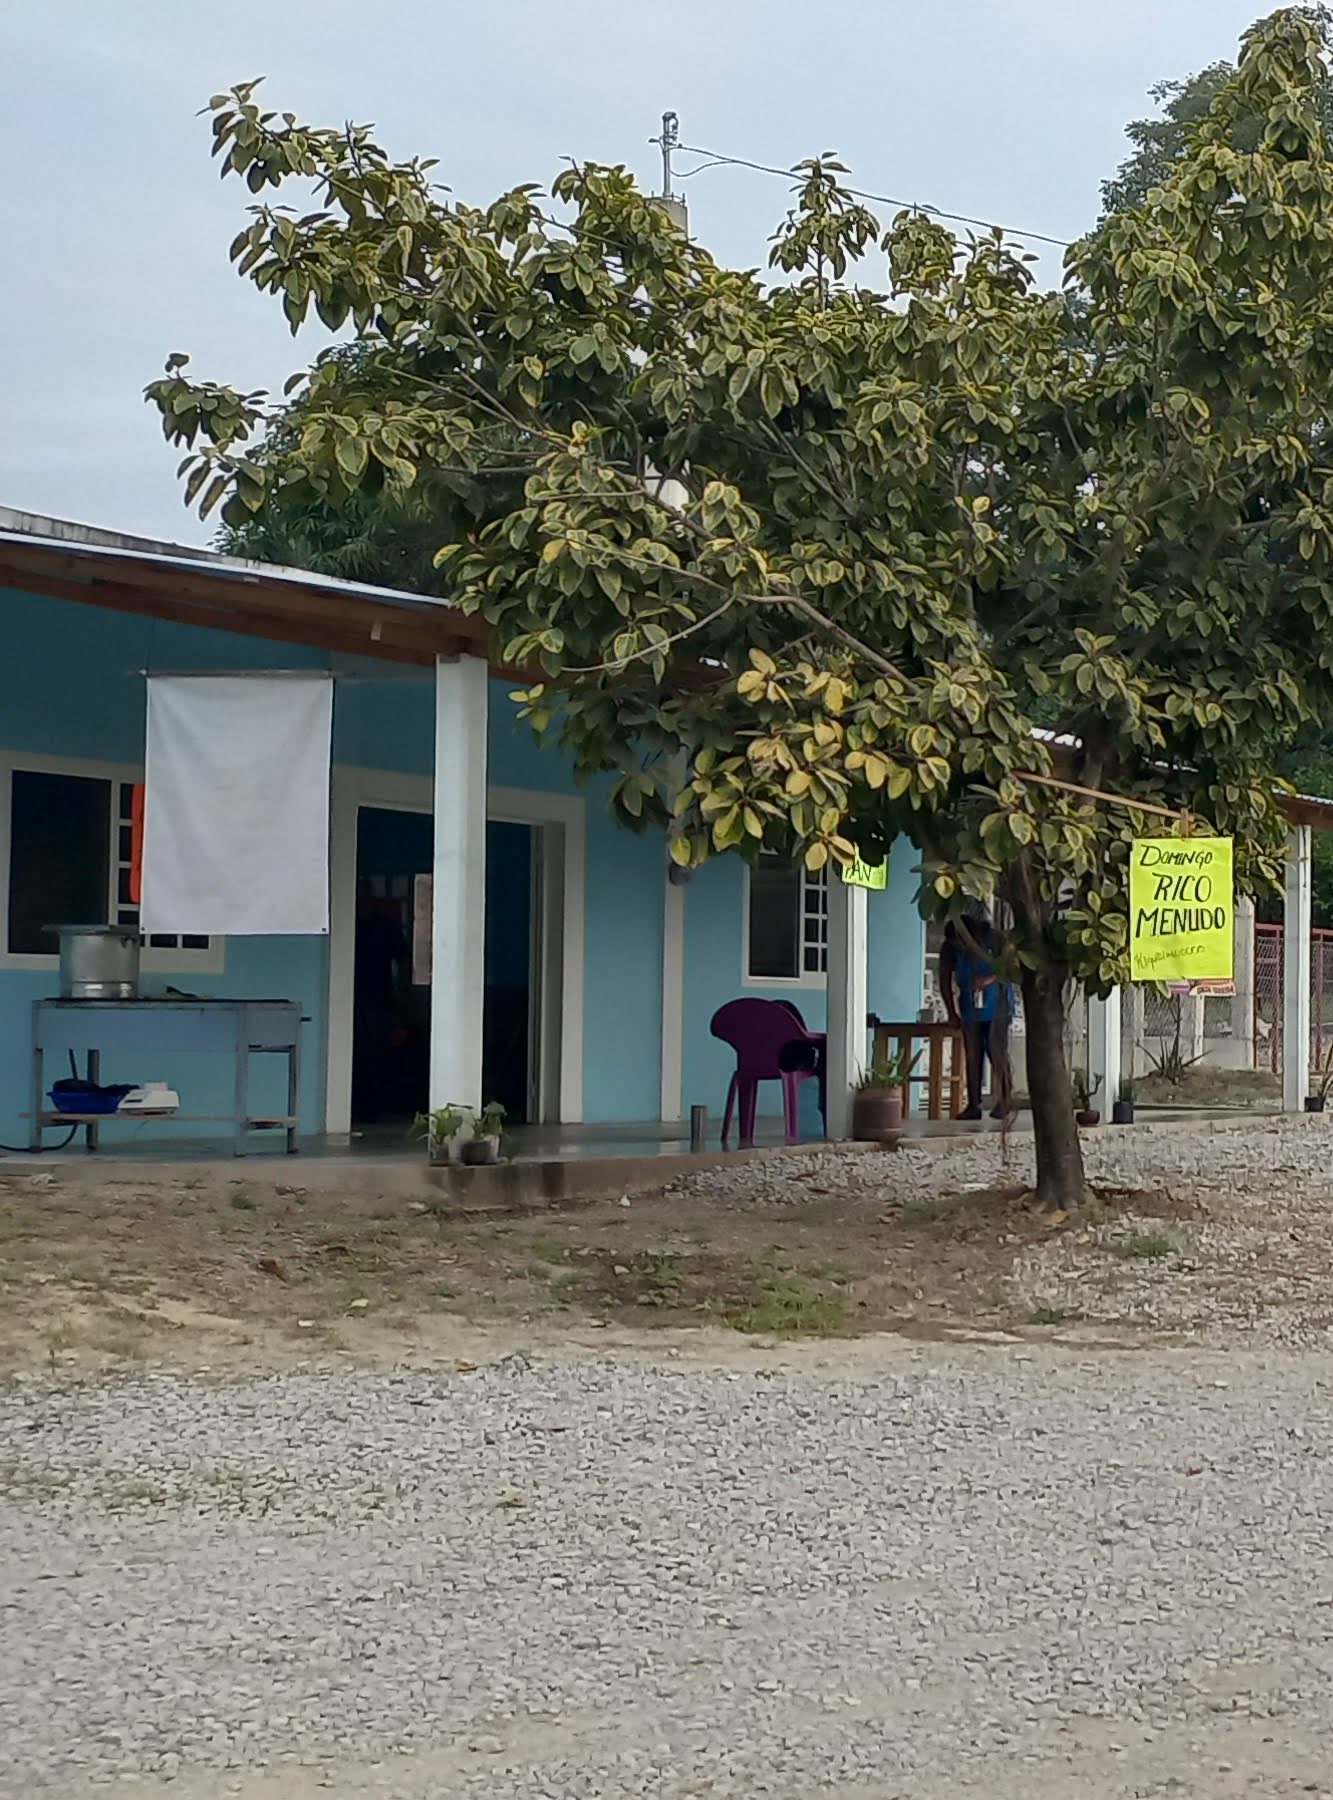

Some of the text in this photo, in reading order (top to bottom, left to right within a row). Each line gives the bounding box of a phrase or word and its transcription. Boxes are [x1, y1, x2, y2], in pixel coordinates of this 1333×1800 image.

[1140, 844, 1213, 870] DOMINGO
[1152, 872, 1212, 902] RICO
[1135, 906, 1226, 938] MENUDO
